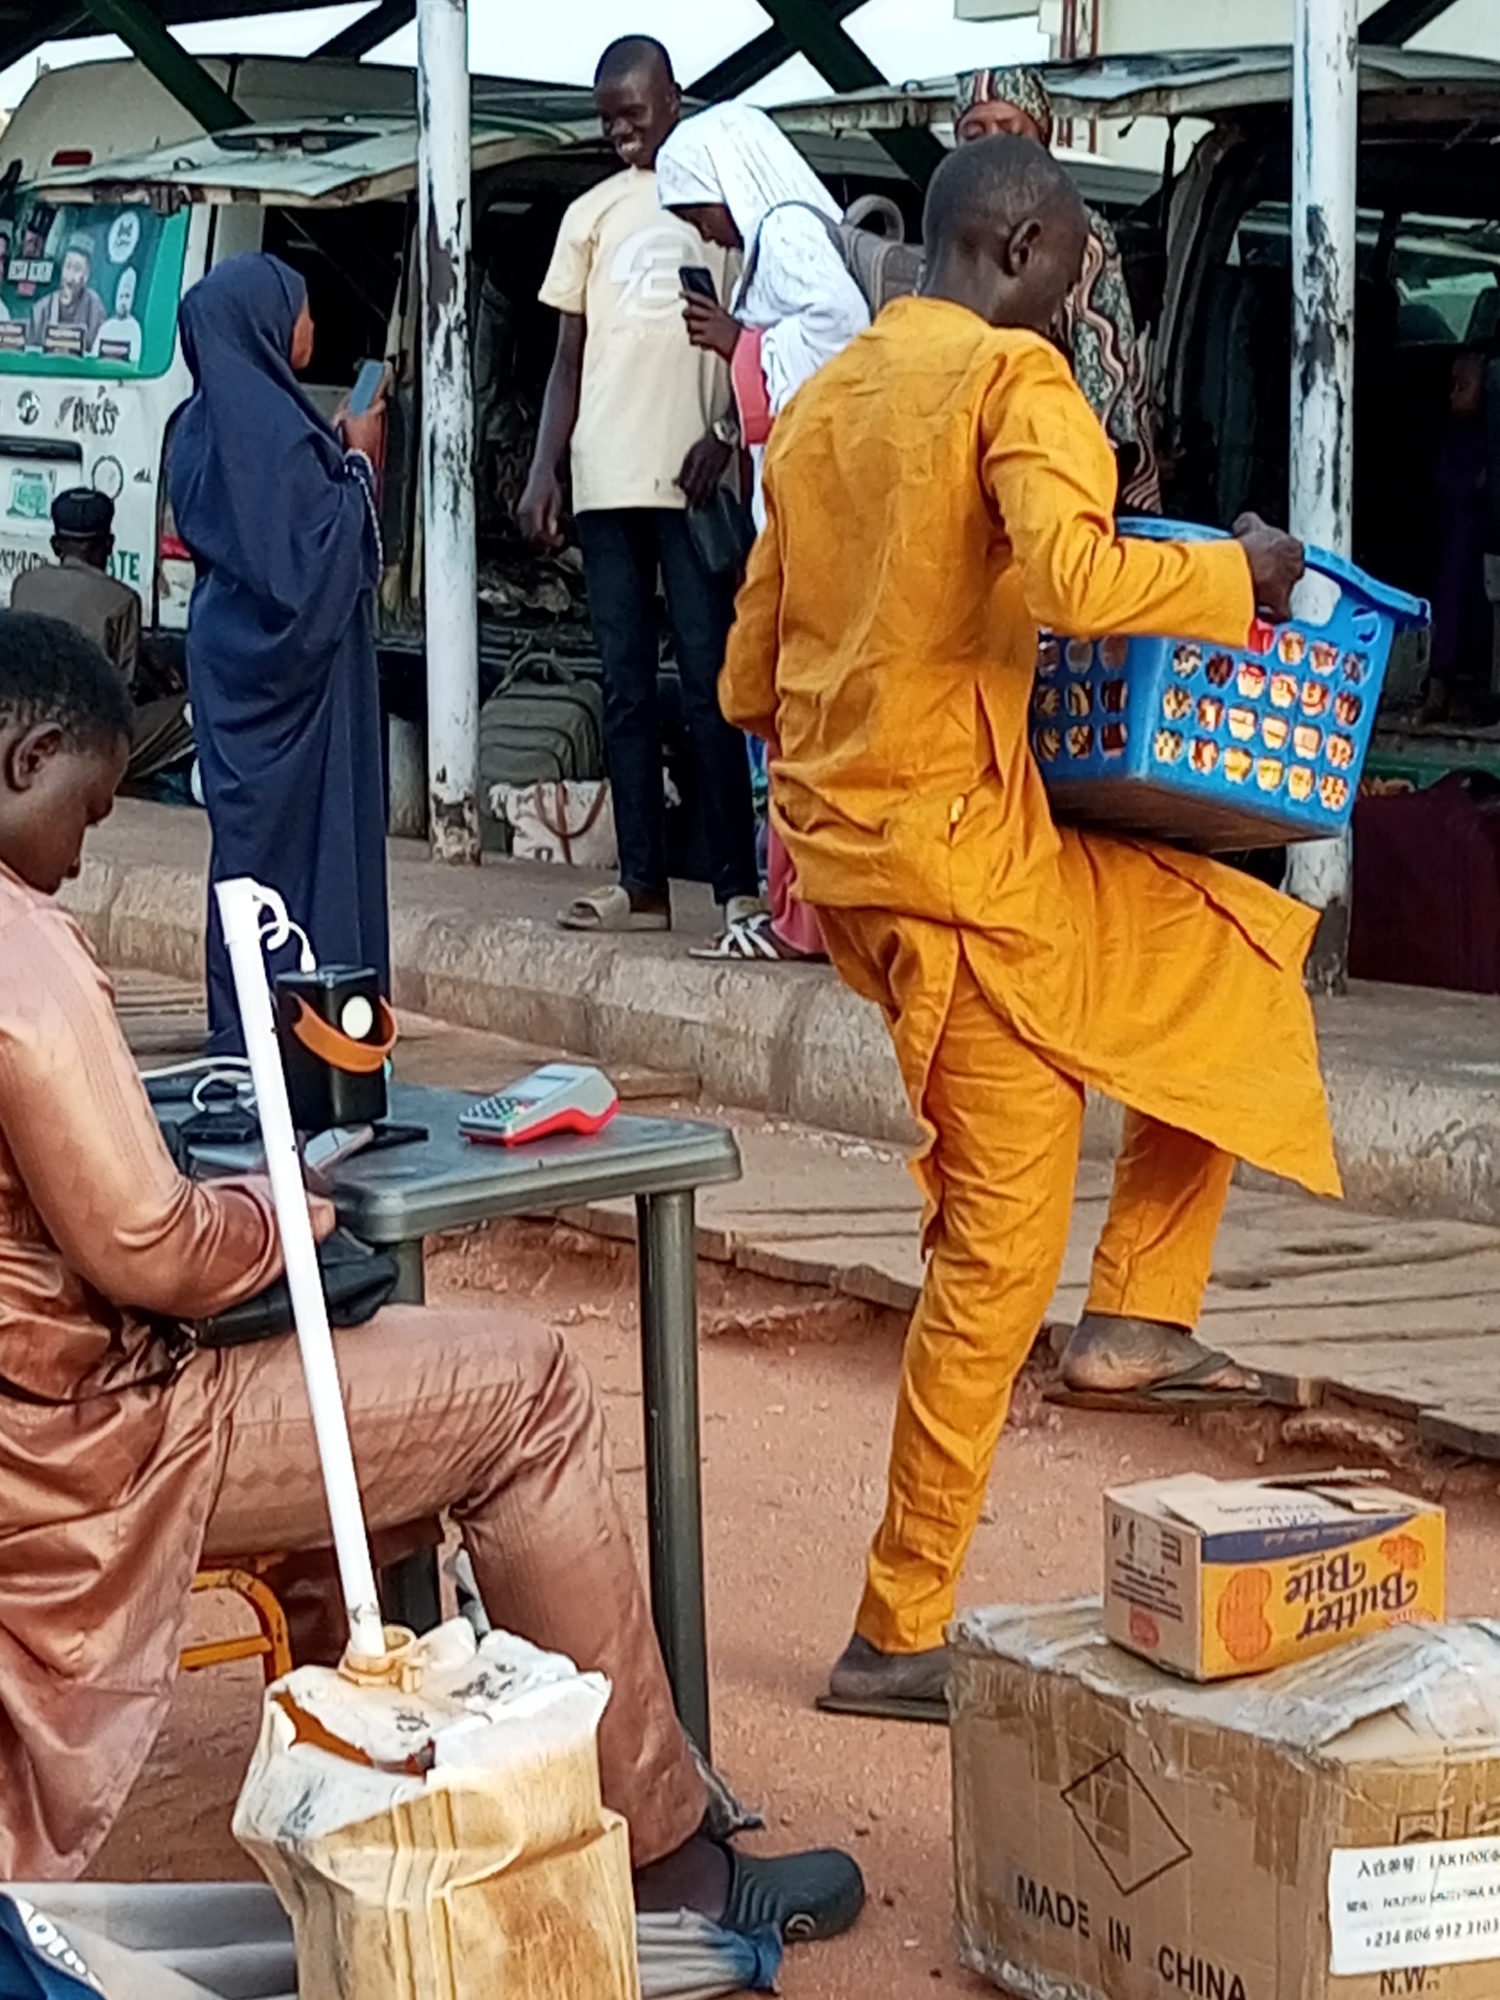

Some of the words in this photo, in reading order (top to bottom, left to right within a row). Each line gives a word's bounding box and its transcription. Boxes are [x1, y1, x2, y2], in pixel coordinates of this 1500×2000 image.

[1283, 1551, 1366, 1605] Bite
[1295, 1571, 1418, 1642] Butter
[1017, 1875, 1090, 1939] MADE
[1108, 1916, 1132, 1962] IN
[1158, 1945, 1247, 2000] CHINA
